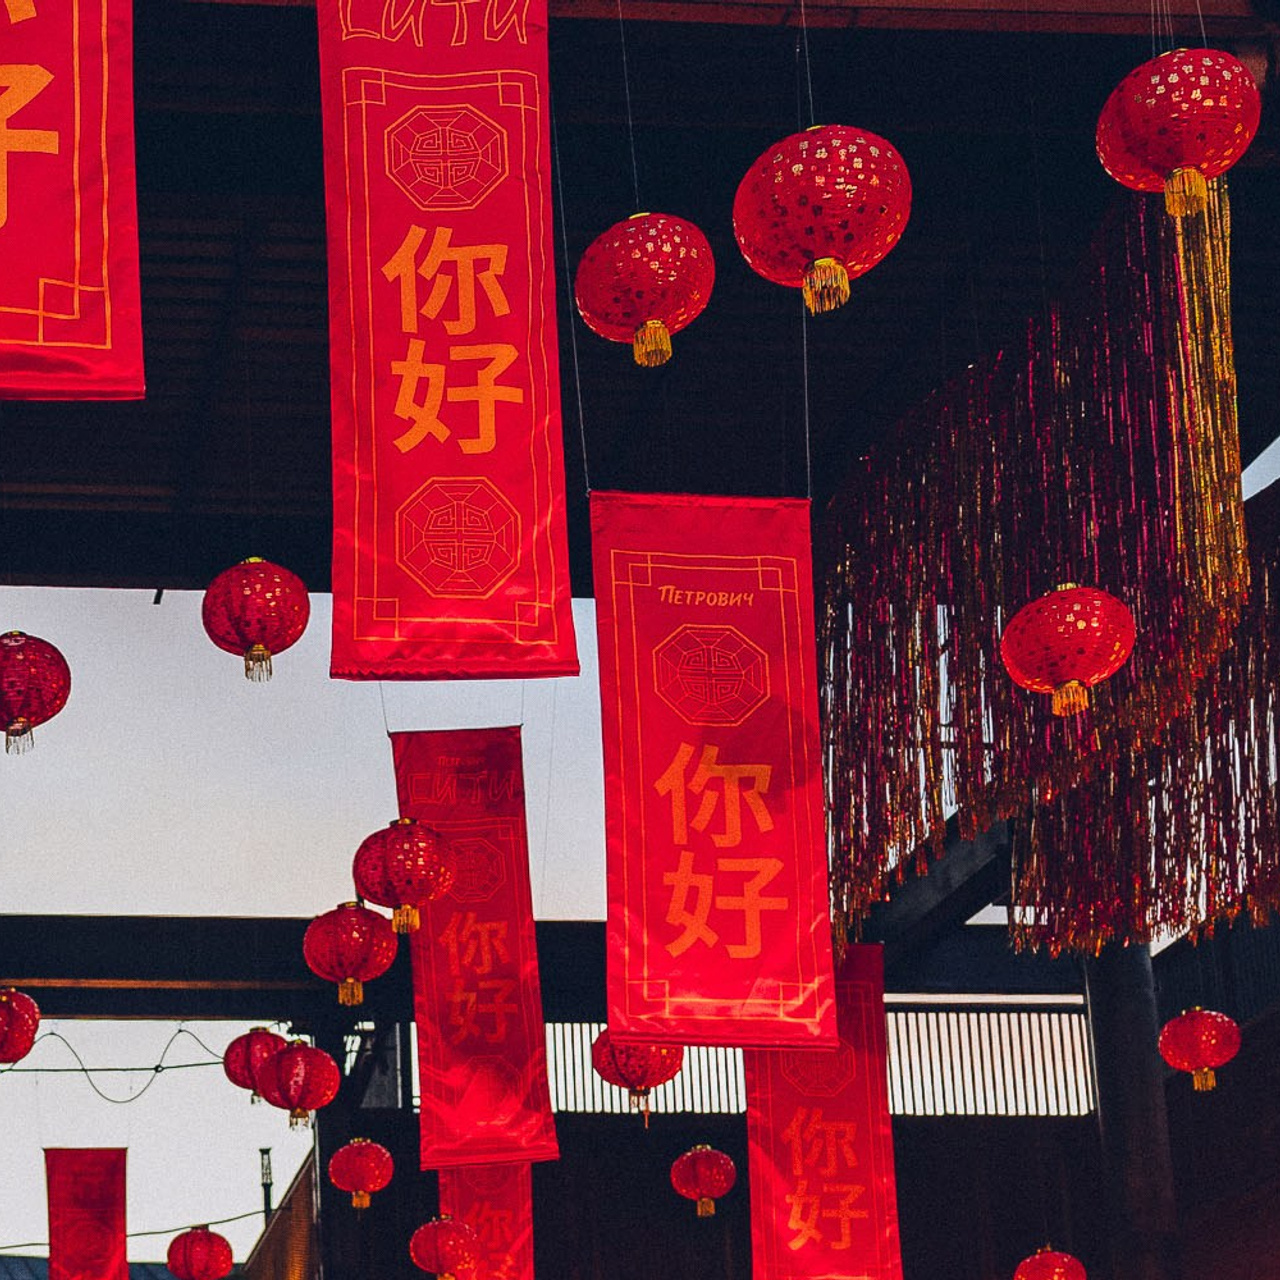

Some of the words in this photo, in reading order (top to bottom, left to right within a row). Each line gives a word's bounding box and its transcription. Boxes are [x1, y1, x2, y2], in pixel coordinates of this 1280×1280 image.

[381, 224, 524, 454] 你好
[654, 742, 788, 959] 你好
[438, 911, 518, 1044] 你好
[780, 1106, 869, 1251] 你好
